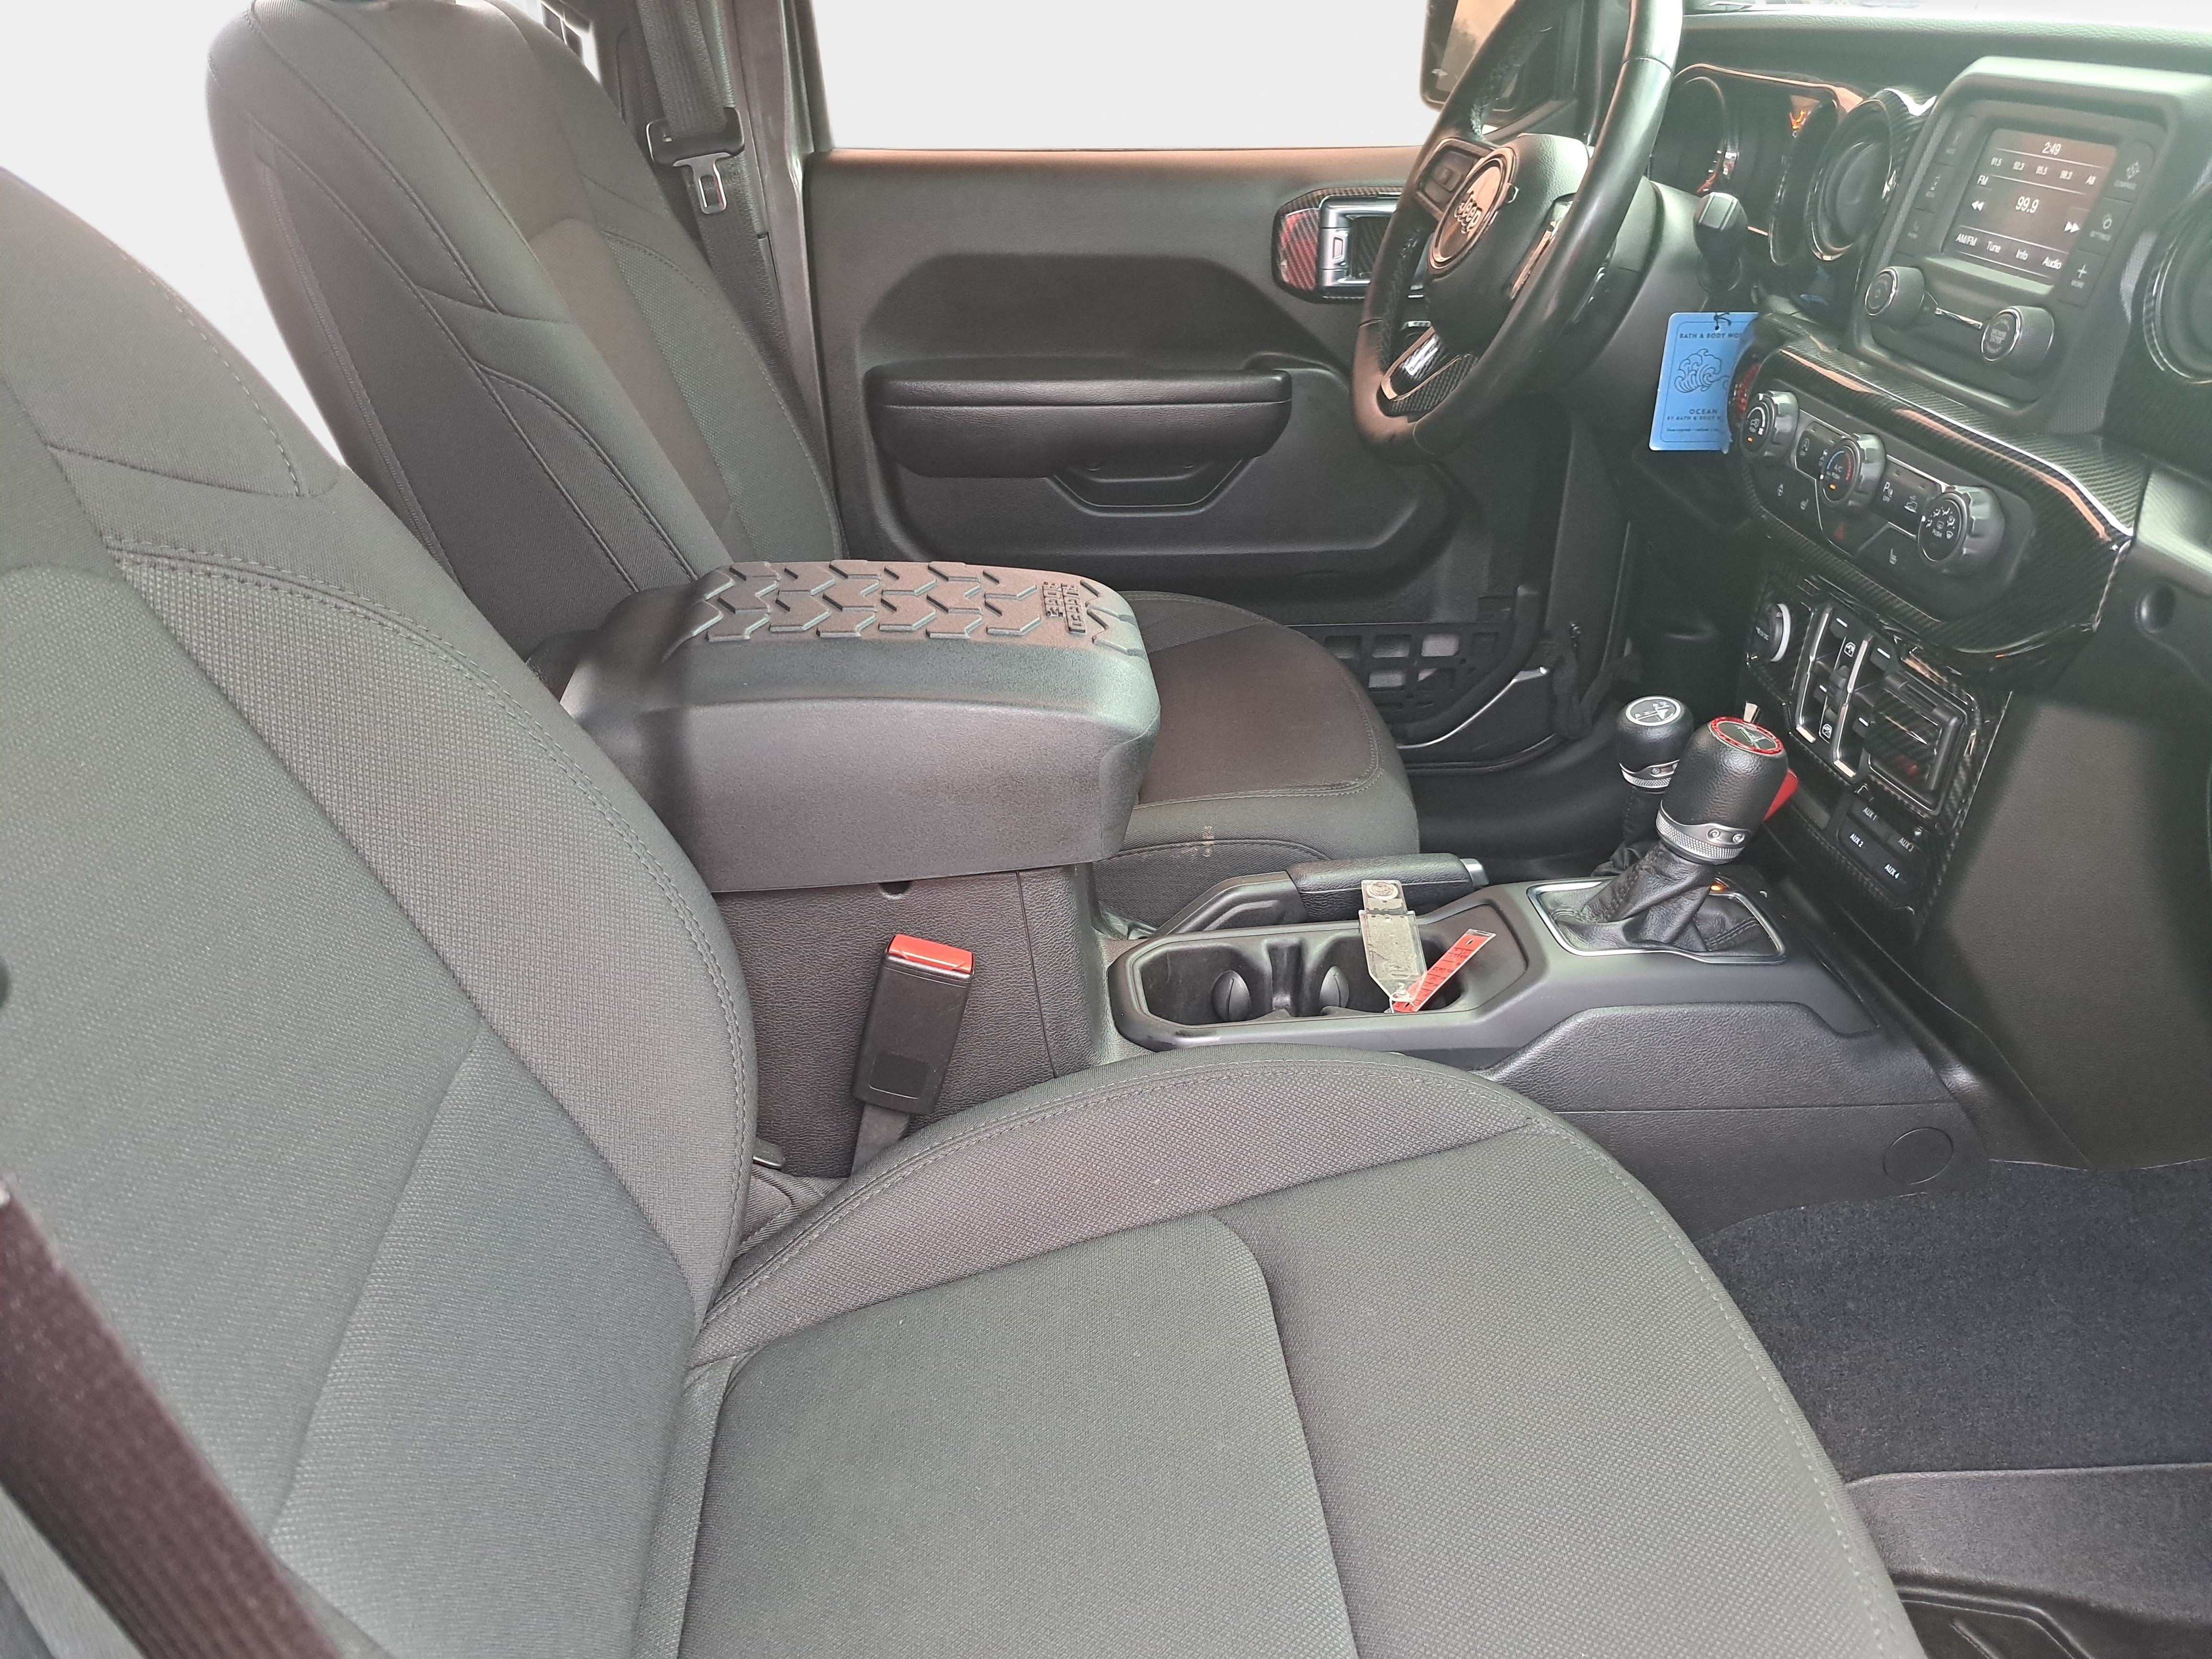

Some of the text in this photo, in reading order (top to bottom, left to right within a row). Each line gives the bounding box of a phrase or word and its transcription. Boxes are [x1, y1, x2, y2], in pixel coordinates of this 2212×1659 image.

[1977, 175, 1989, 186] FM
[2015, 196, 2040, 213] 99.9
[1455, 195, 1482, 233] Jeep
[1956, 233, 2062, 270] AM/FM Tune Info Audio
[1061, 583, 1085, 631] RUGGED
[1862, 807, 1875, 818] AUX
[1849, 833, 1861, 845] AUX
[1898, 838, 1911, 850] AUX
[1884, 864, 1896, 876] AUX
